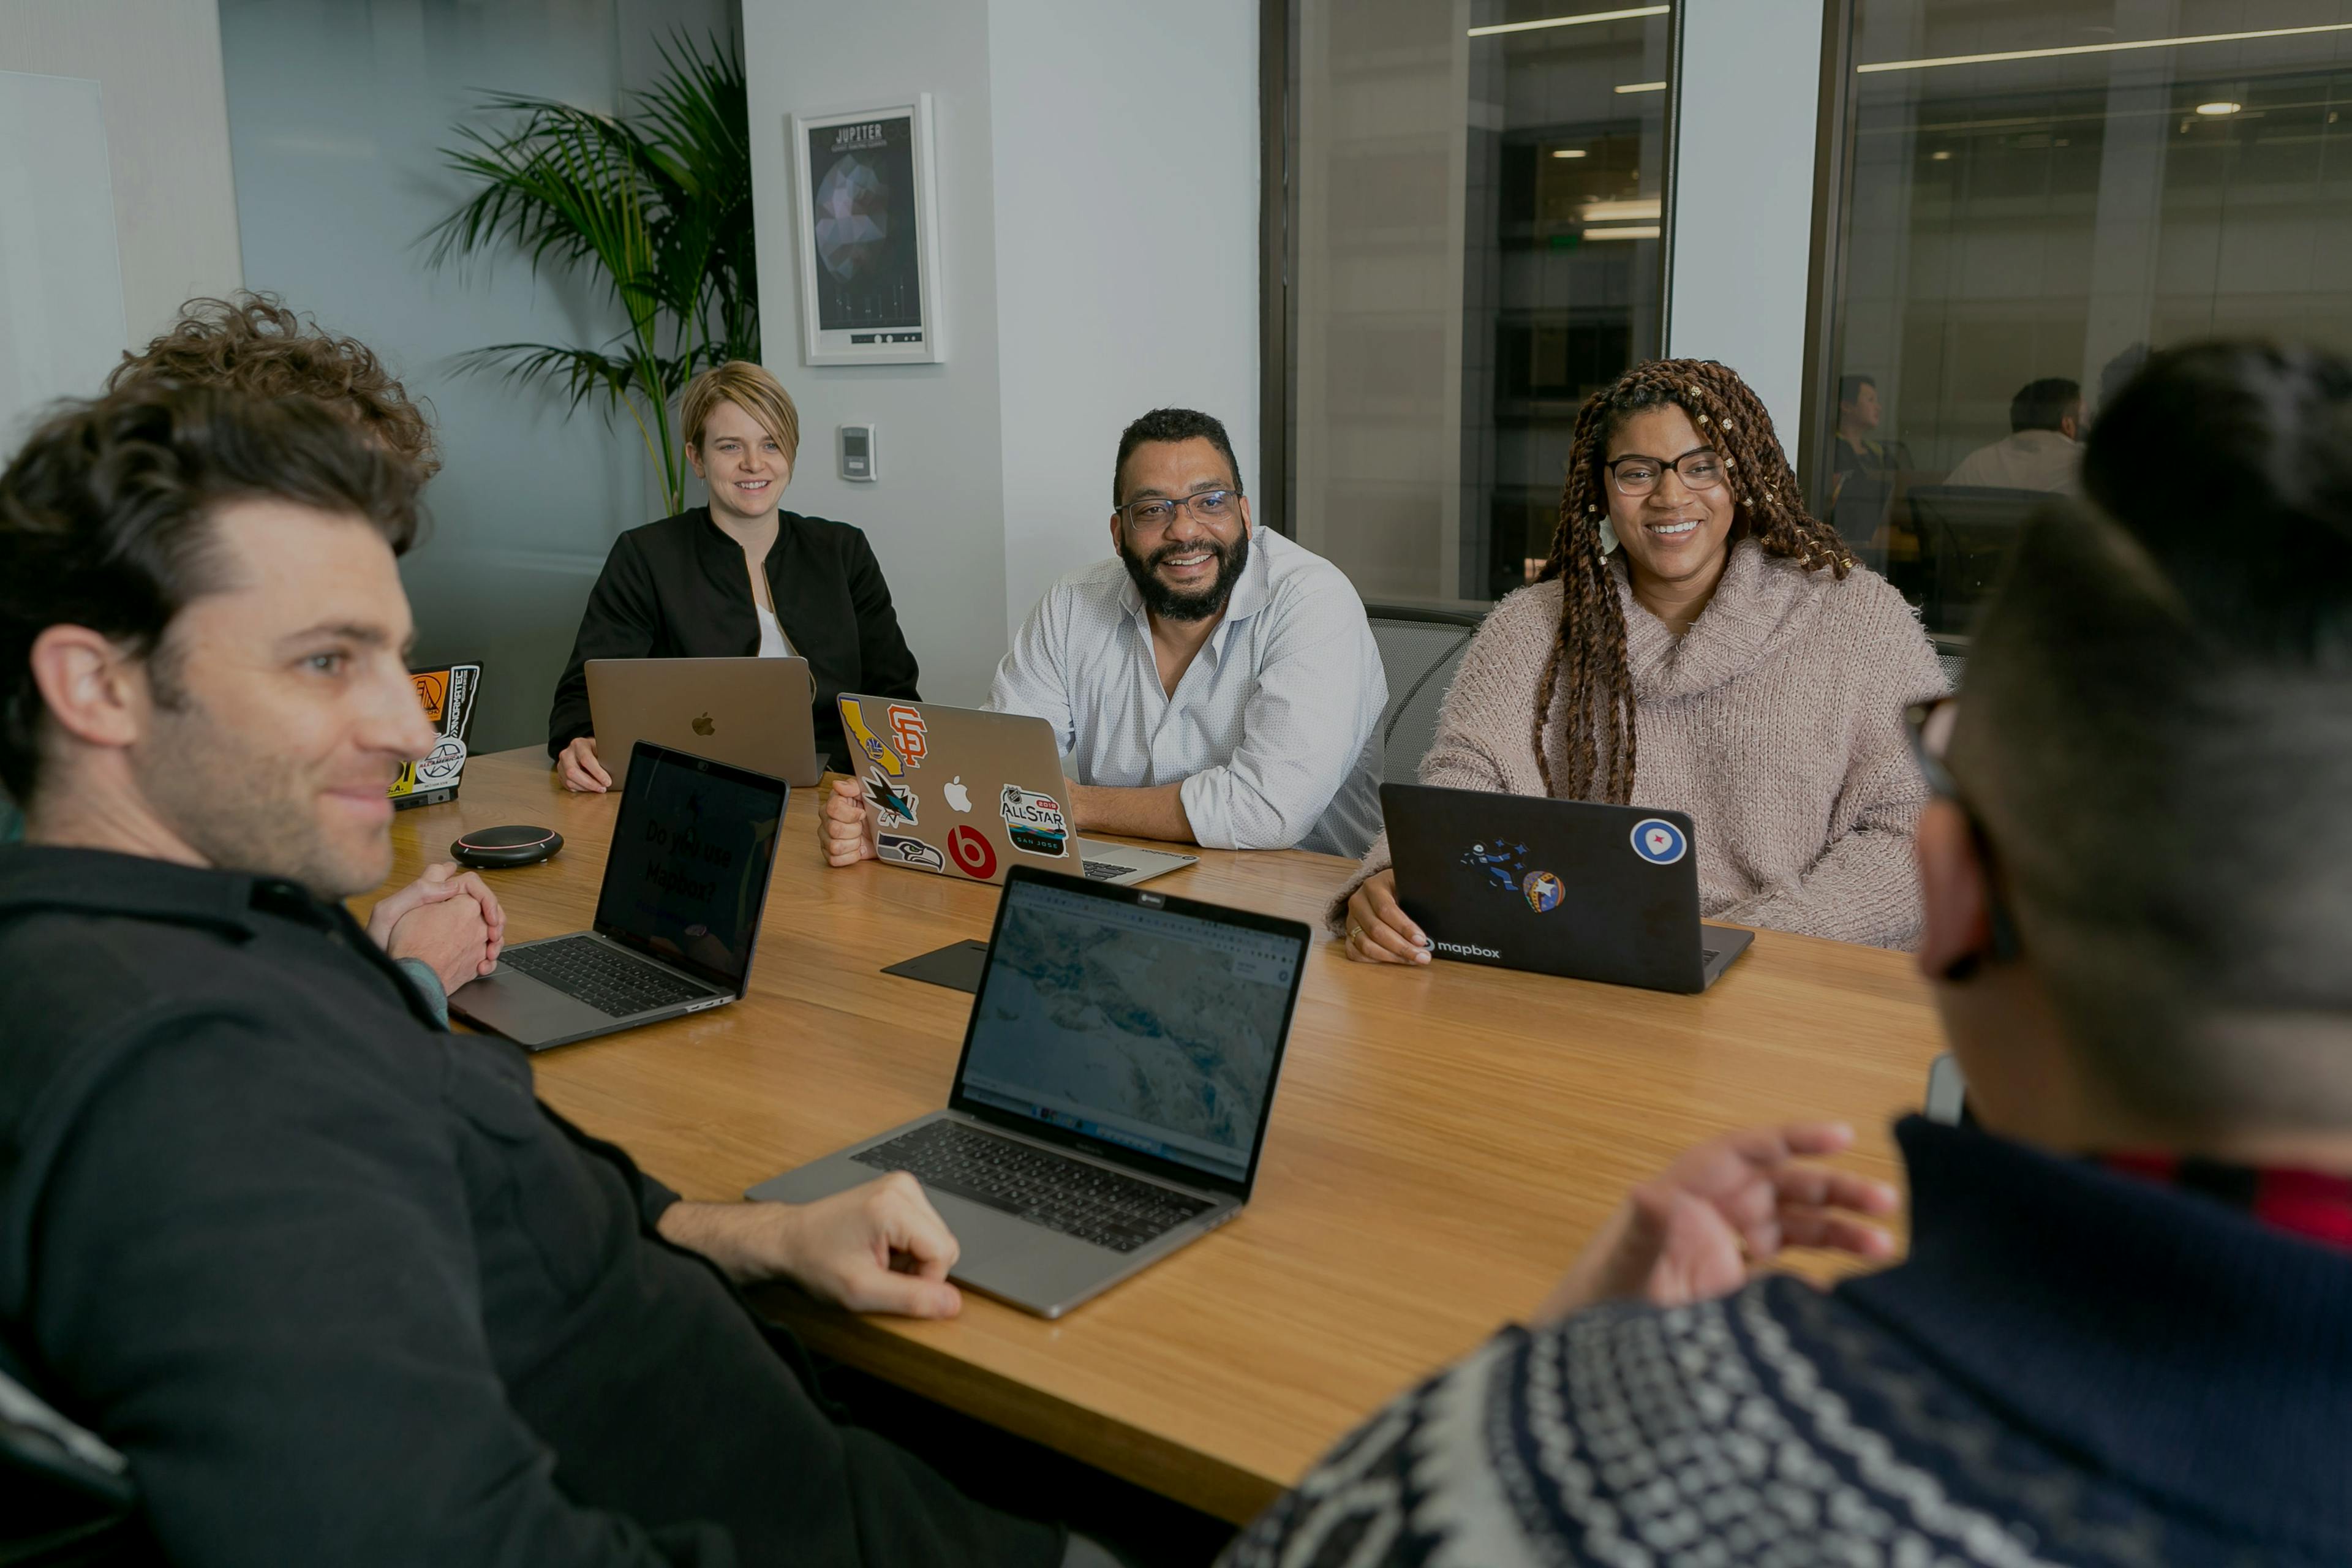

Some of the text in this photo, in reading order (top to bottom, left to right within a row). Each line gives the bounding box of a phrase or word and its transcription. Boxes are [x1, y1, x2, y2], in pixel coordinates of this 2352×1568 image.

[836, 124, 882, 143] JUPITER
[452, 670, 464, 726] NORMATEC
[888, 706, 927, 767] SF
[646, 819, 667, 845] Do
[704, 844, 731, 869] use
[1036, 840, 1058, 849] JOSE
[645, 859, 715, 903] Mapbox?
[1438, 942, 1500, 959] mapbox
